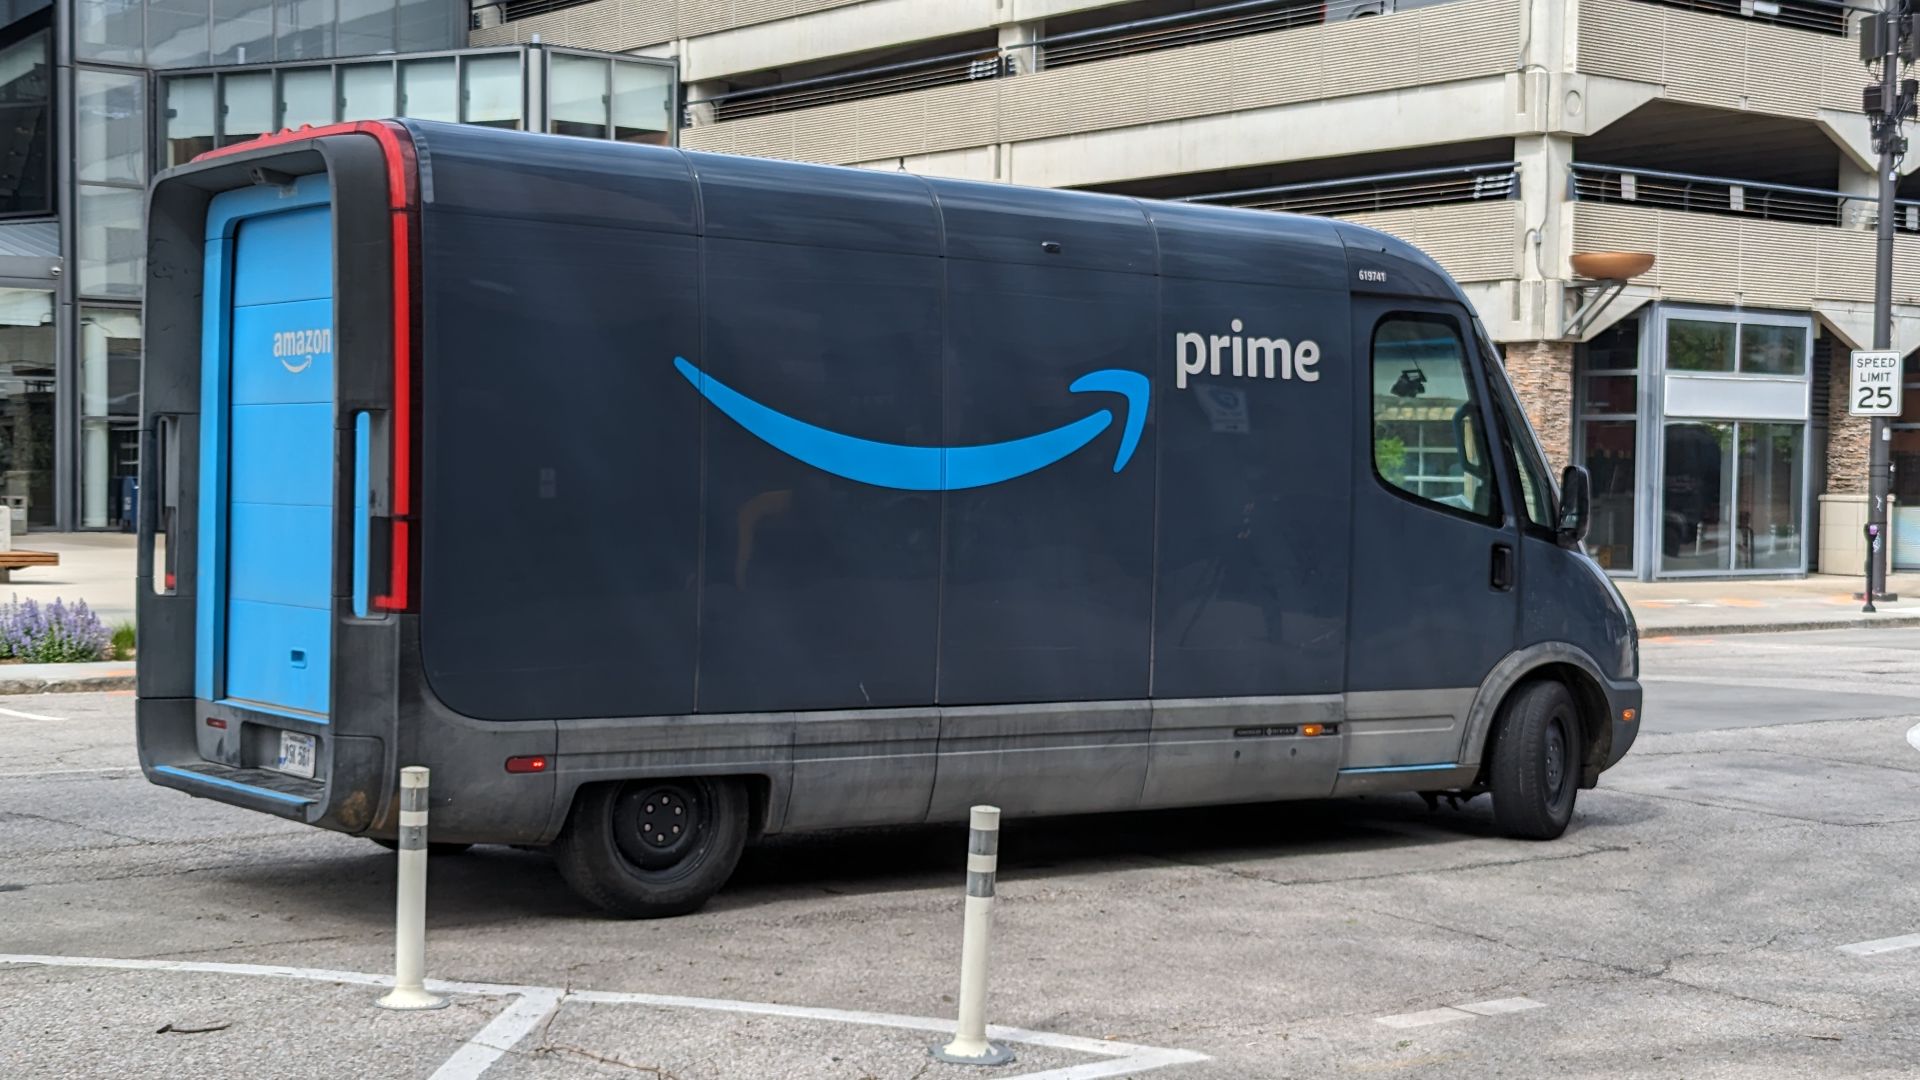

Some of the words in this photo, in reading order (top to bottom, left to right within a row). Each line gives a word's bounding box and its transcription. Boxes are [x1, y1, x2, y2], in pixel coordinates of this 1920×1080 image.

[1359, 270, 1387, 283] 619741
[273, 329, 332, 357] amazon
[1176, 319, 1320, 389] prime
[1857, 358, 1896, 368] SPEED
[1859, 372, 1891, 383] LIMIT
[1857, 386, 1893, 409] 25
